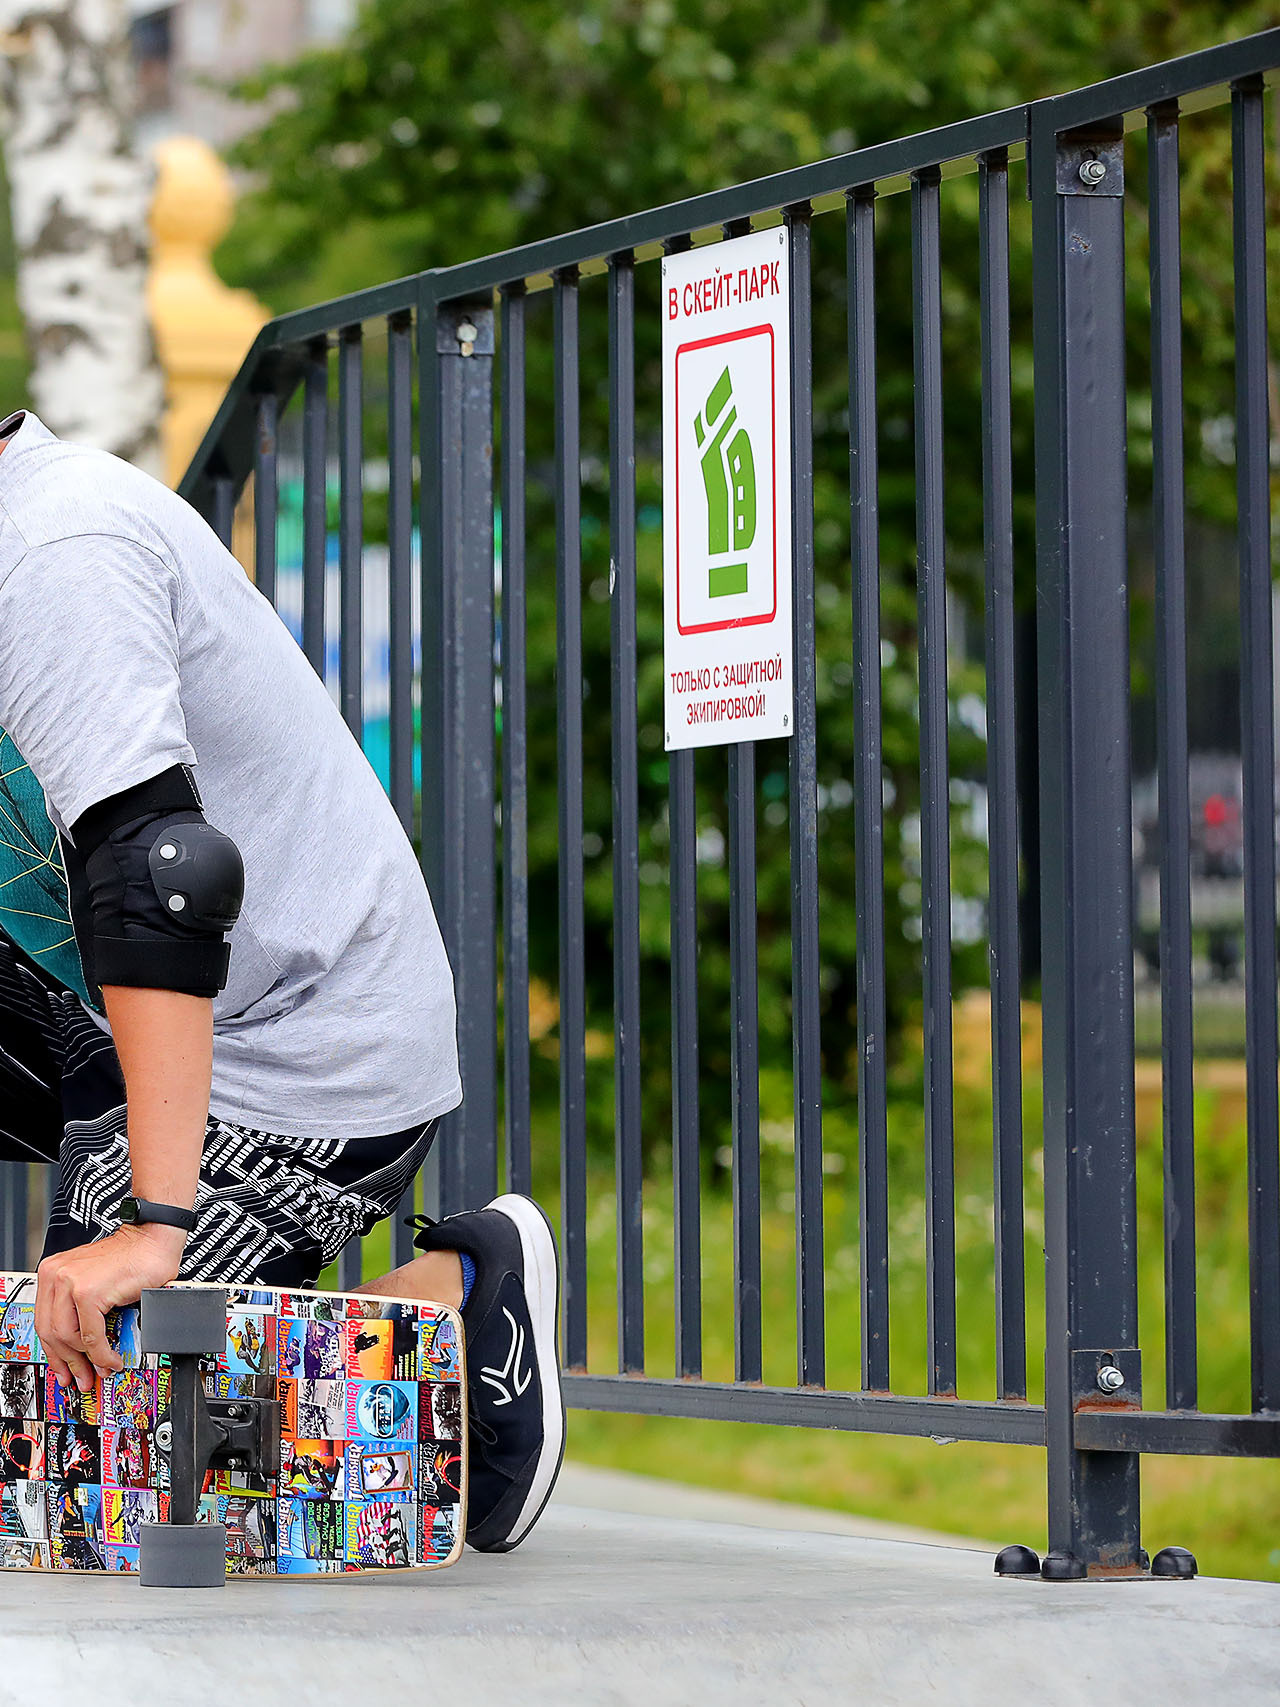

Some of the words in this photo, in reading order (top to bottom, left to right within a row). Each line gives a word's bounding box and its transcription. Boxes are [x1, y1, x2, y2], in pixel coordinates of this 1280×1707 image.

[669, 287, 678, 320] В
[683, 260, 780, 317] СКЕЙТ-ПАРК
[670, 667, 711, 694] ТОЛЬКО
[713, 666, 720, 688] С
[723, 651, 782, 688] ЗАЩИТНОЙ
[686, 688, 766, 725] ЭКИПИРОВКОЙ!
[346, 1319, 365, 1379] THRASHER
[103, 1373, 117, 1426] THRASHE
[280, 1379, 292, 1433] THRASHER
[346, 1381, 362, 1438] THRASHER
[102, 1429, 116, 1485] THRASHER
[147, 1433, 158, 1472] POOLS
[346, 1443, 365, 1502] THRASHER
[103, 1490, 118, 1542] THRASHER
[279, 1498, 294, 1557] THRASHER
[307, 1501, 316, 1541] MUMFORD
[346, 1503, 364, 1561] THRASHER
